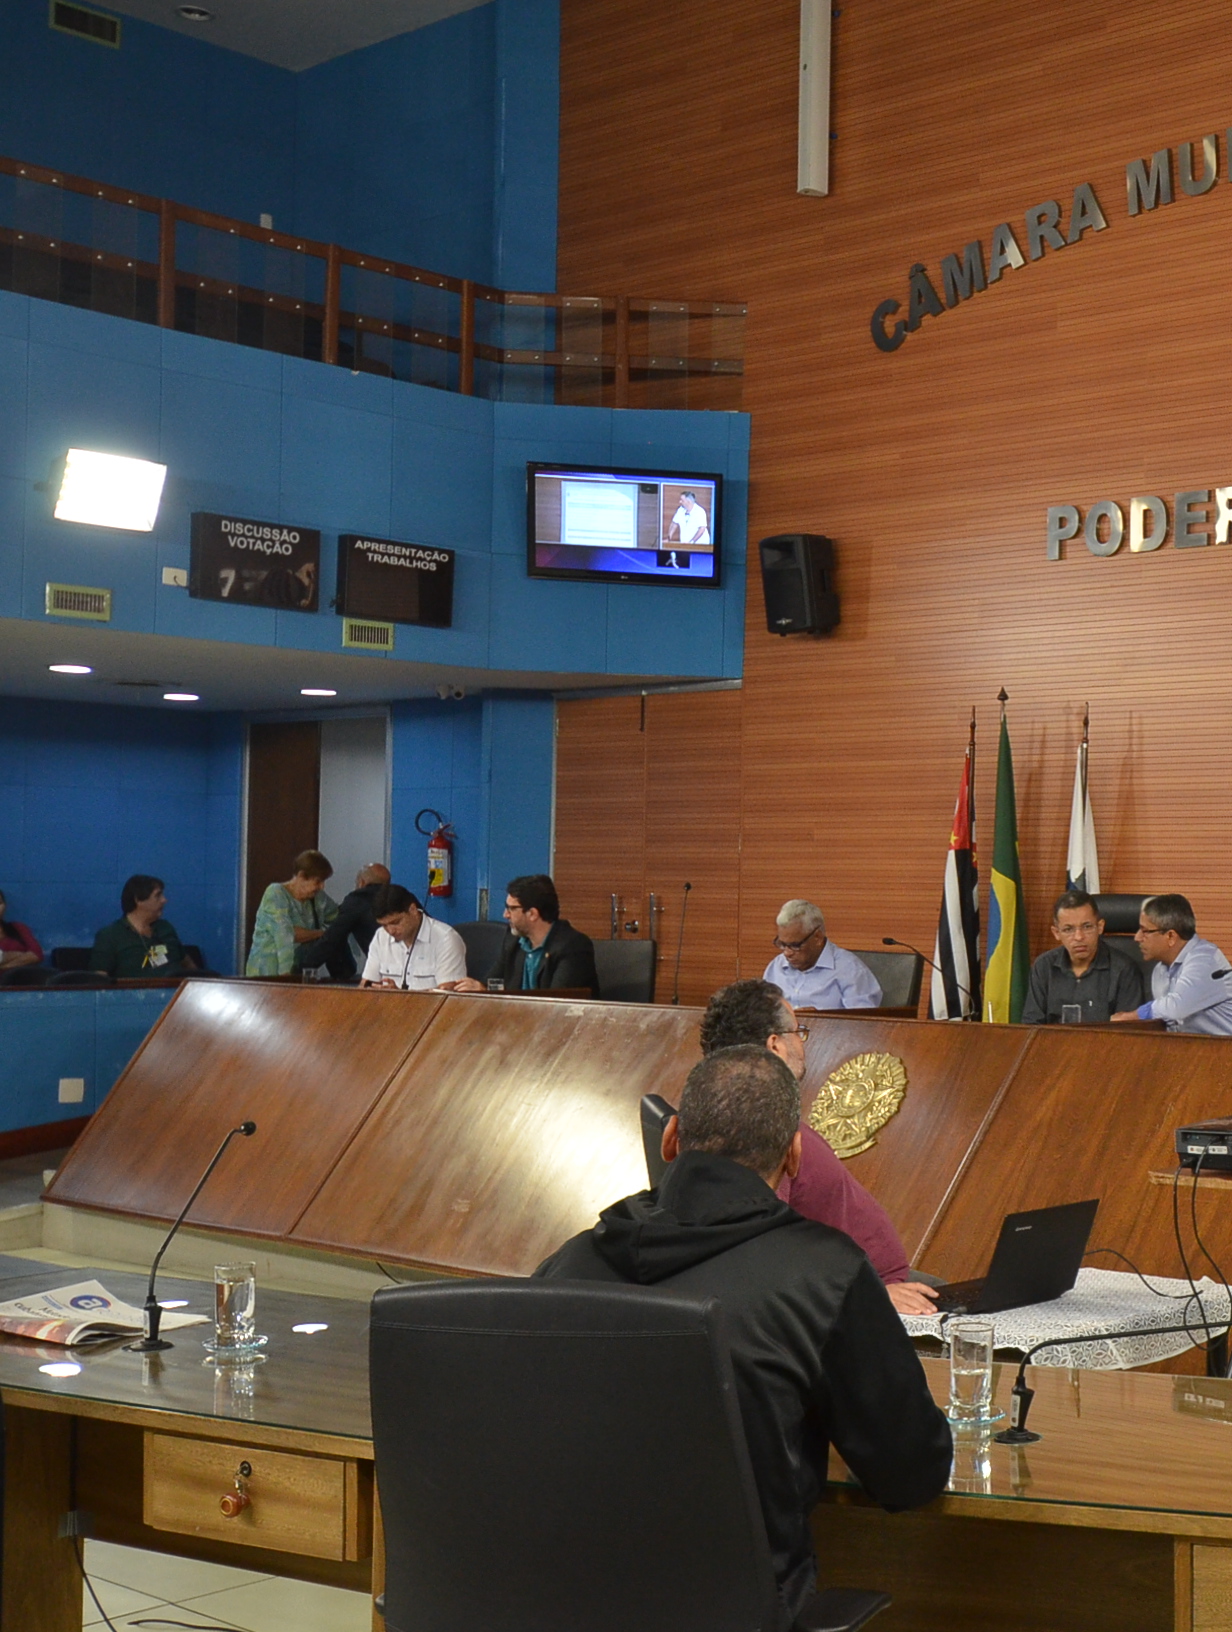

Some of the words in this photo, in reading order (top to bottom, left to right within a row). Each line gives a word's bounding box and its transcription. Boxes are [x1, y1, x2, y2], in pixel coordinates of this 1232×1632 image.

[871, 182, 1109, 354] CÂMARA
[221, 520, 300, 544] DISCUSSÃO
[228, 535, 292, 556] VOTAÇÃO
[354, 539, 449, 563] APRESENTAÇÃO
[367, 552, 437, 572] TRABALHOS
